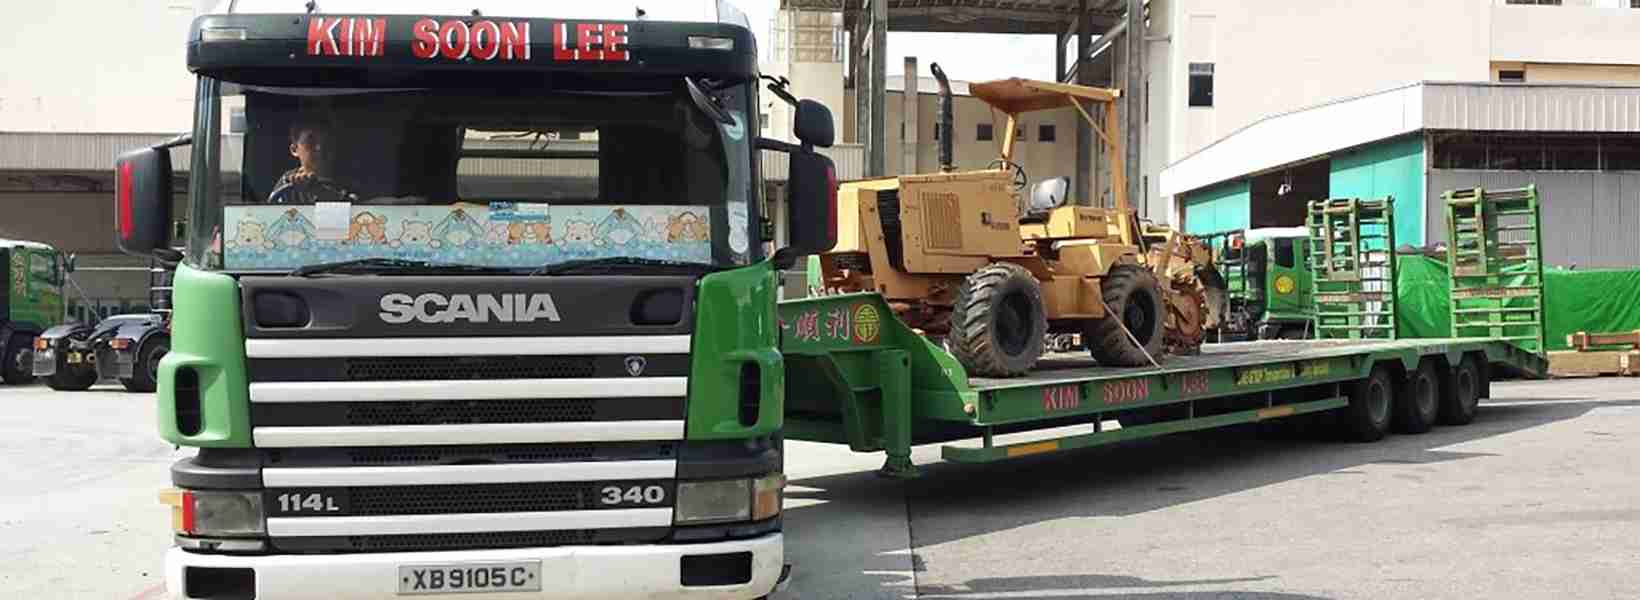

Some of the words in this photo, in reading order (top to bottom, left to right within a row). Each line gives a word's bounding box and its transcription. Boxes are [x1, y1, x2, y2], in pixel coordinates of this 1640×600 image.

[307, 15, 387, 57] KIM
[412, 17, 531, 60] SOON
[552, 22, 630, 62] LEE
[379, 293, 560, 323] SCANIA
[1043, 384, 1080, 411] KIM
[1103, 378, 1149, 404] SOON
[601, 486, 665, 505] 340
